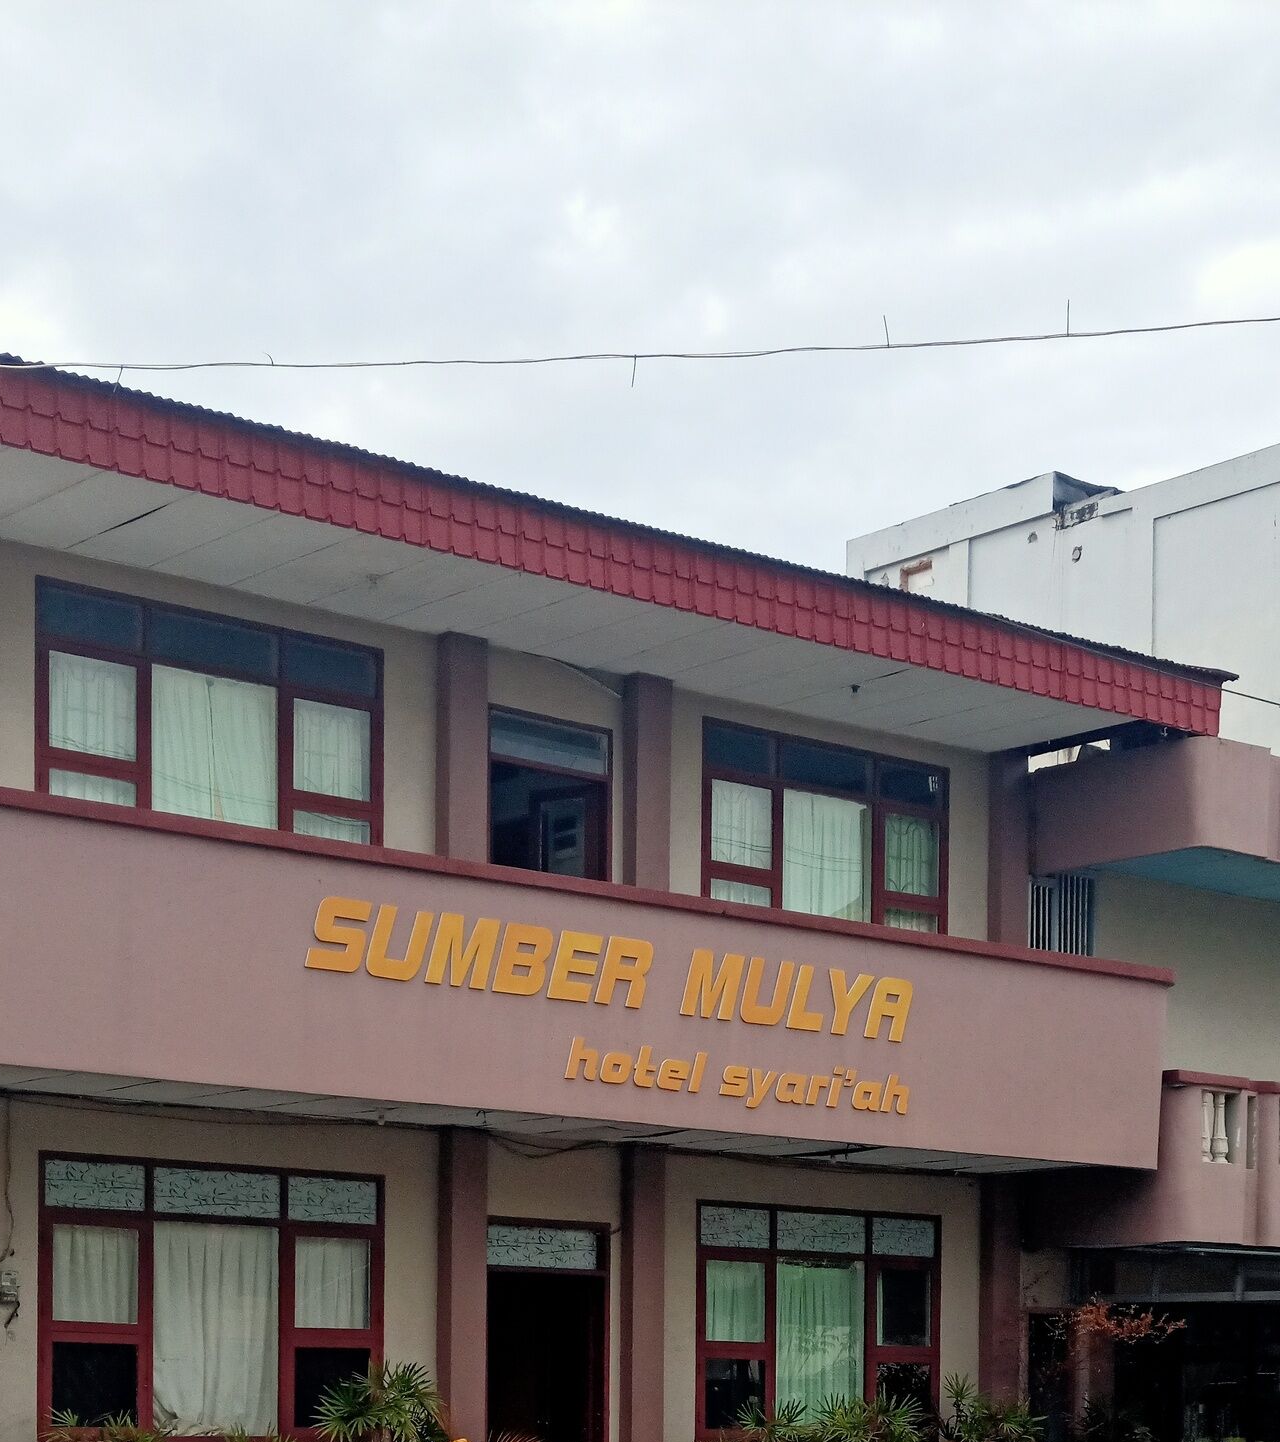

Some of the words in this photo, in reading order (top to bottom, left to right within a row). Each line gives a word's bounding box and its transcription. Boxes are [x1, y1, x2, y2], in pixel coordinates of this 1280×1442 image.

[305, 896, 653, 1009] SUMBER
[680, 948, 913, 1043] MULYA
[564, 1036, 709, 1093] hotel
[718, 1064, 910, 1115] syari'ah
